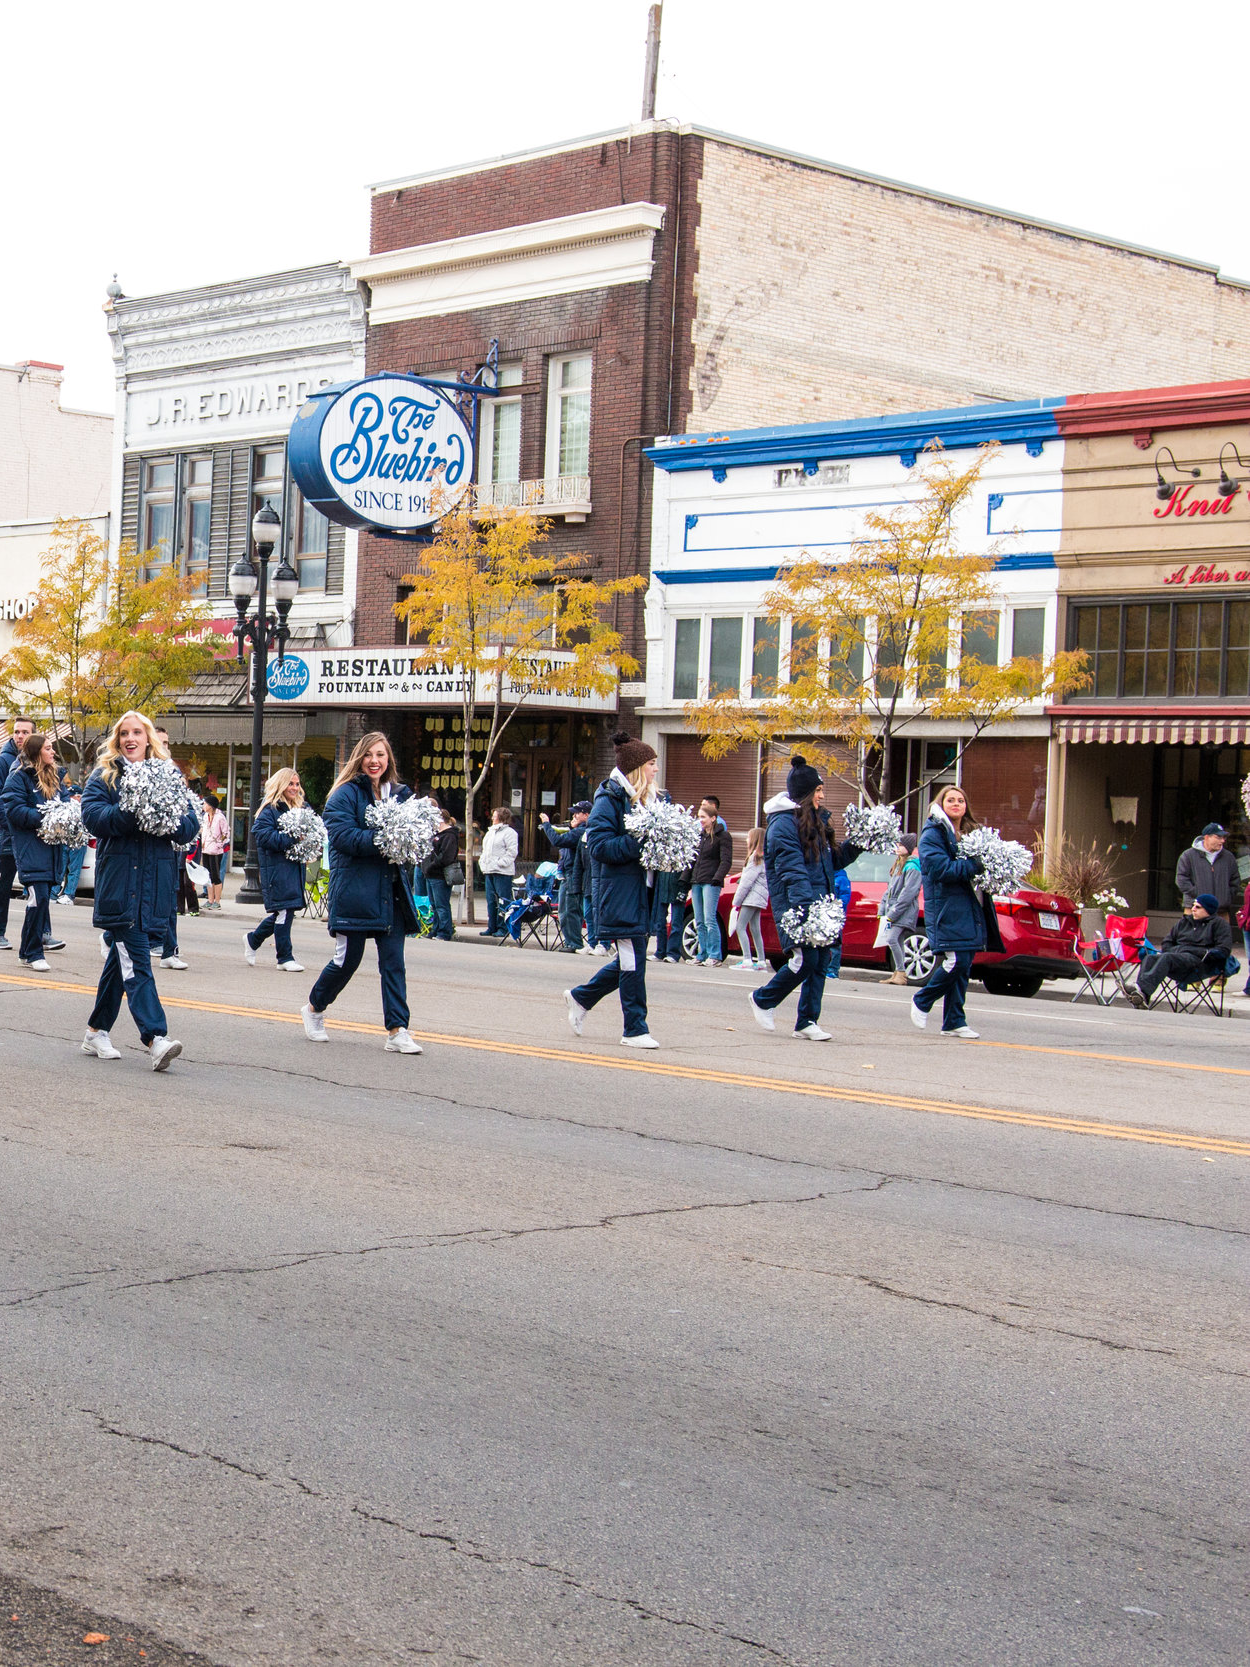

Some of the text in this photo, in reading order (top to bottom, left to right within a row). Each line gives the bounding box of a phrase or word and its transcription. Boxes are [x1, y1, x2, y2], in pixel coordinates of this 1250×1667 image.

[388, 396, 441, 444] The
[329, 391, 466, 485] Bluebird
[353, 489, 403, 511] SINCE
[1163, 564, 1189, 584] A
[1183, 563, 1230, 589] fiber
[320, 658, 469, 677] RESTAURAN
[318, 681, 385, 693] FOUNTAIN
[401, 682, 410, 693] &
